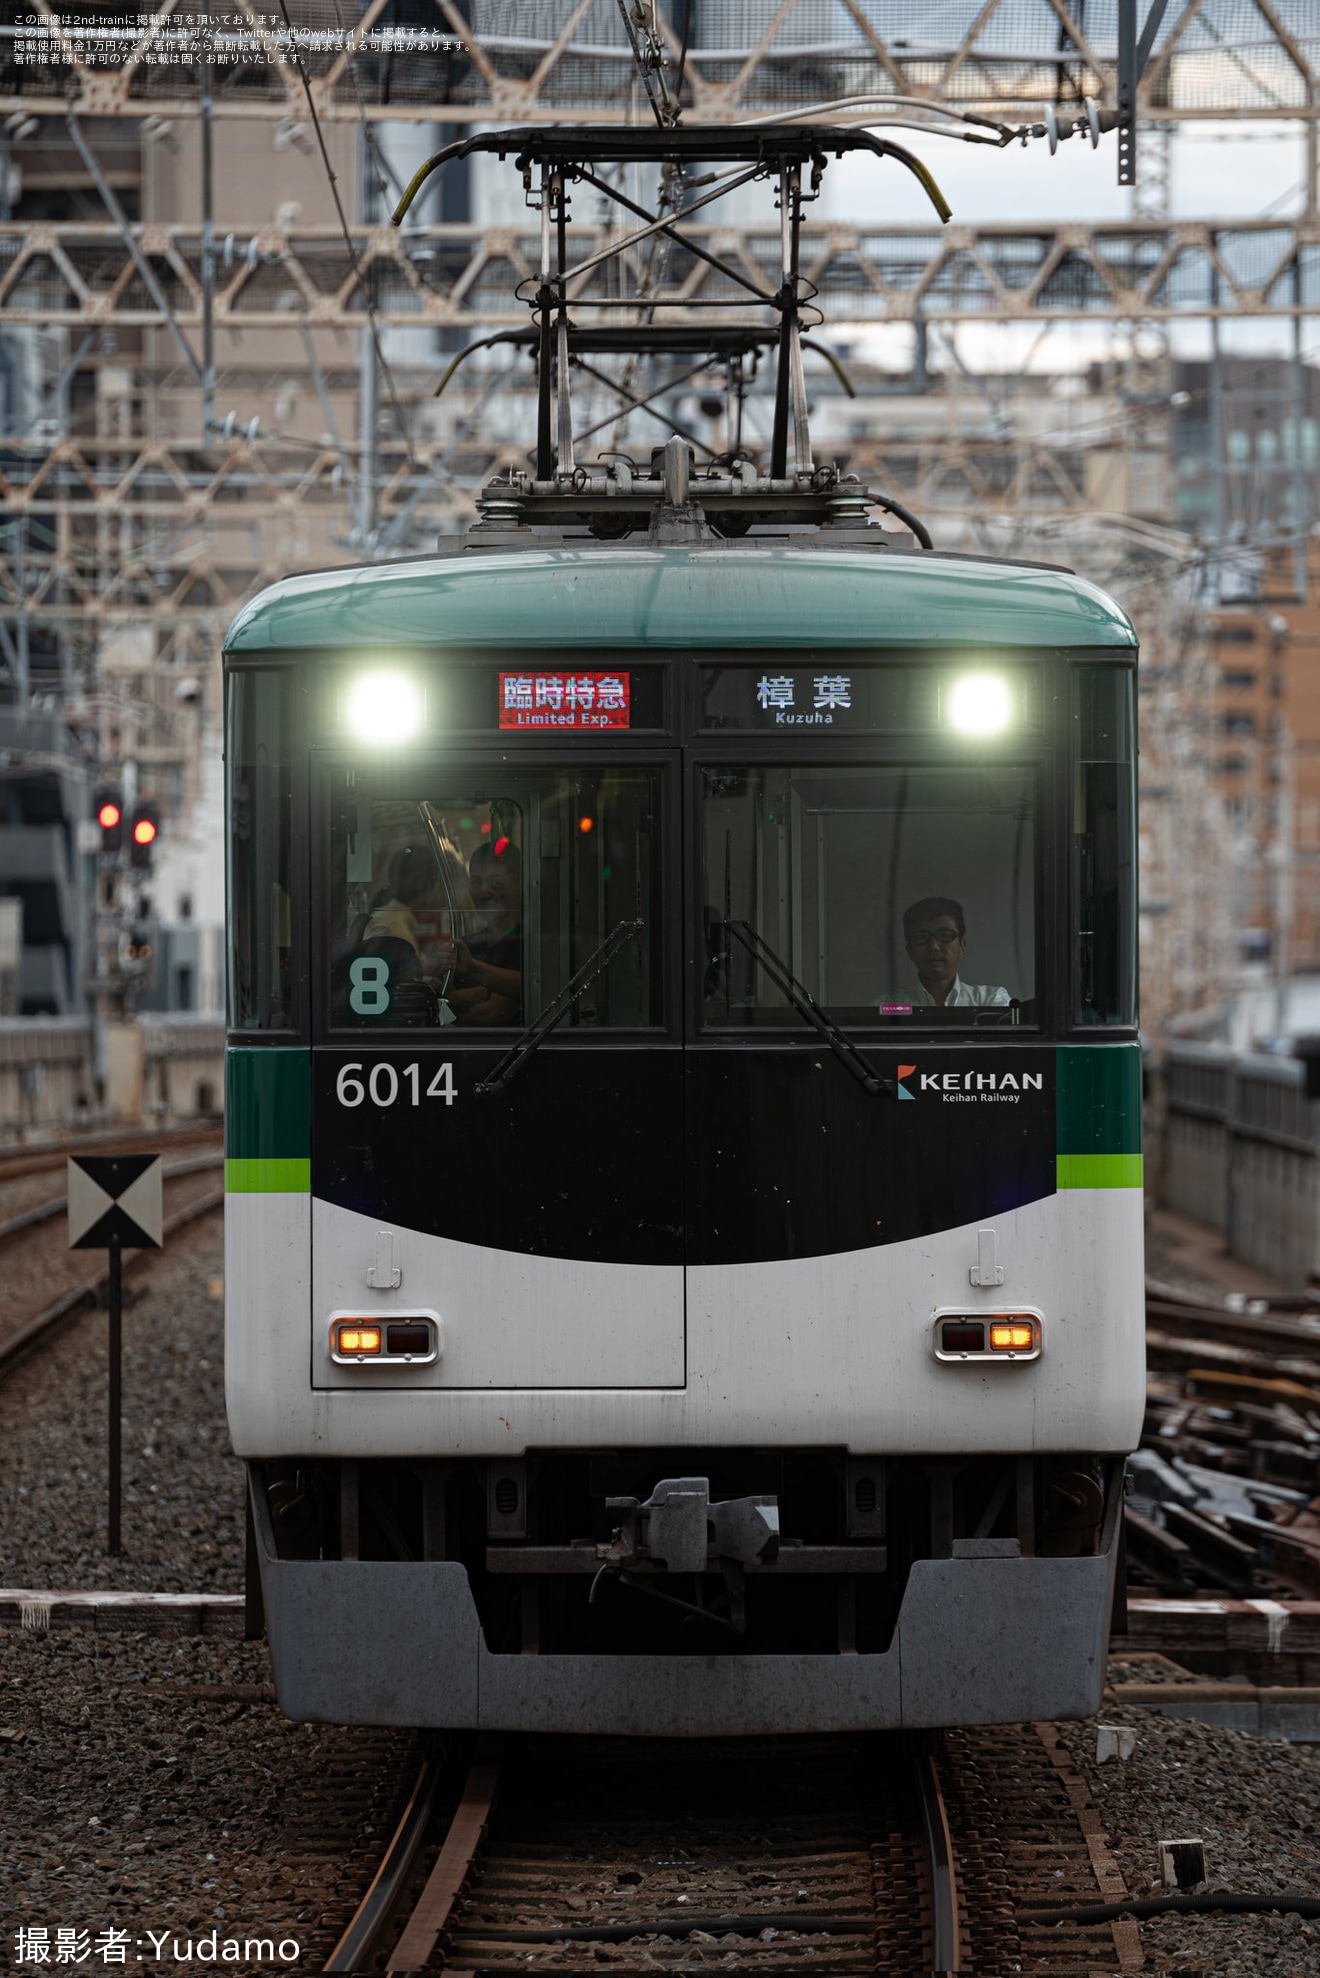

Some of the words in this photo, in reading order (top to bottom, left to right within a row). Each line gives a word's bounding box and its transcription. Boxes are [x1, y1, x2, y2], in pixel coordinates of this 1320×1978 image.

[504, 676, 626, 710] 臨時特急
[517, 713, 575, 725] Limited
[581, 713, 613, 728] Exp.
[775, 711, 833, 724] Kuzuha
[349, 956, 390, 1015] 8
[336, 1062, 458, 1108] 6014
[920, 1070, 1043, 1090] KEIHAN
[942, 1093, 977, 1102] Keihan
[980, 1093, 1020, 1103] Railway
